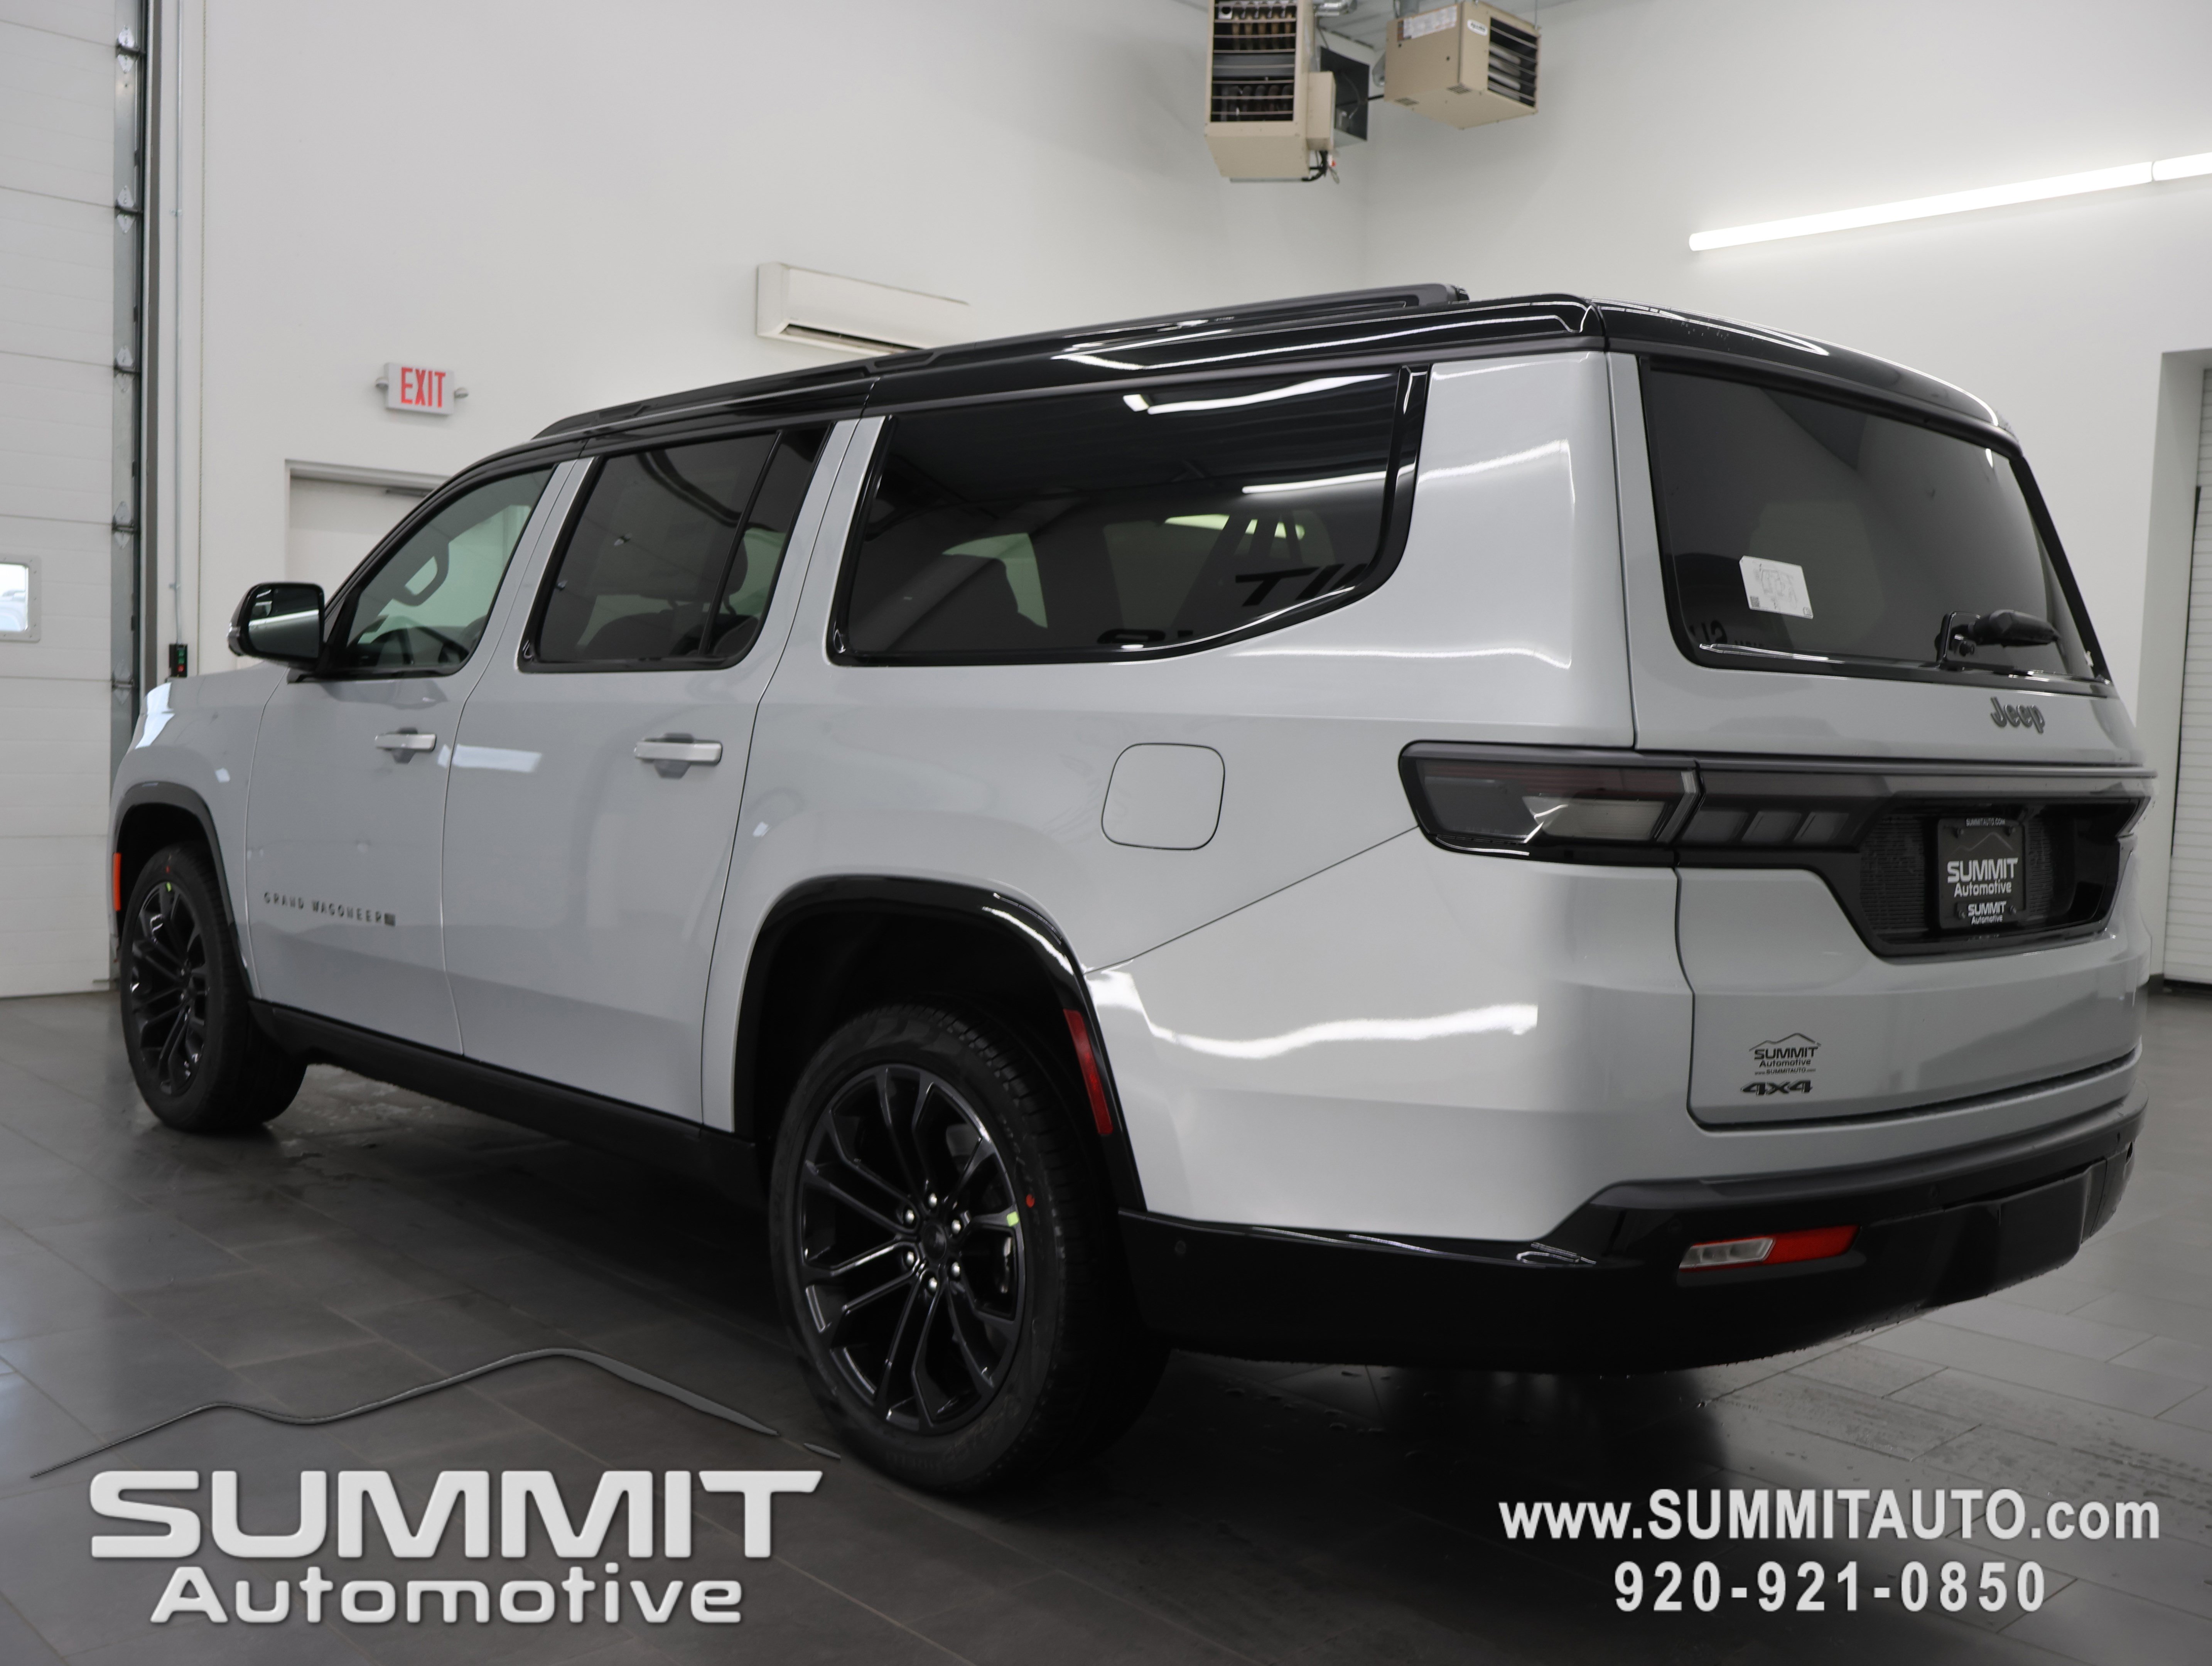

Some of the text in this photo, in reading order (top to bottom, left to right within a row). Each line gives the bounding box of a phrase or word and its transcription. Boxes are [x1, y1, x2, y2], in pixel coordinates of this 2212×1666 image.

[401, 366, 446, 408] EXIT
[1990, 696, 2045, 734] Jeep
[1947, 857, 2018, 883] SUMMIT
[1954, 879, 2012, 897] Automotive
[263, 892, 382, 923] GRAND WAGONEER
[1967, 901, 2006, 917] SUMMIT
[1971, 914, 2003, 925] Automotive
[1754, 1046, 1818, 1061] SUMMIT
[1759, 1058, 1811, 1068] Automotive
